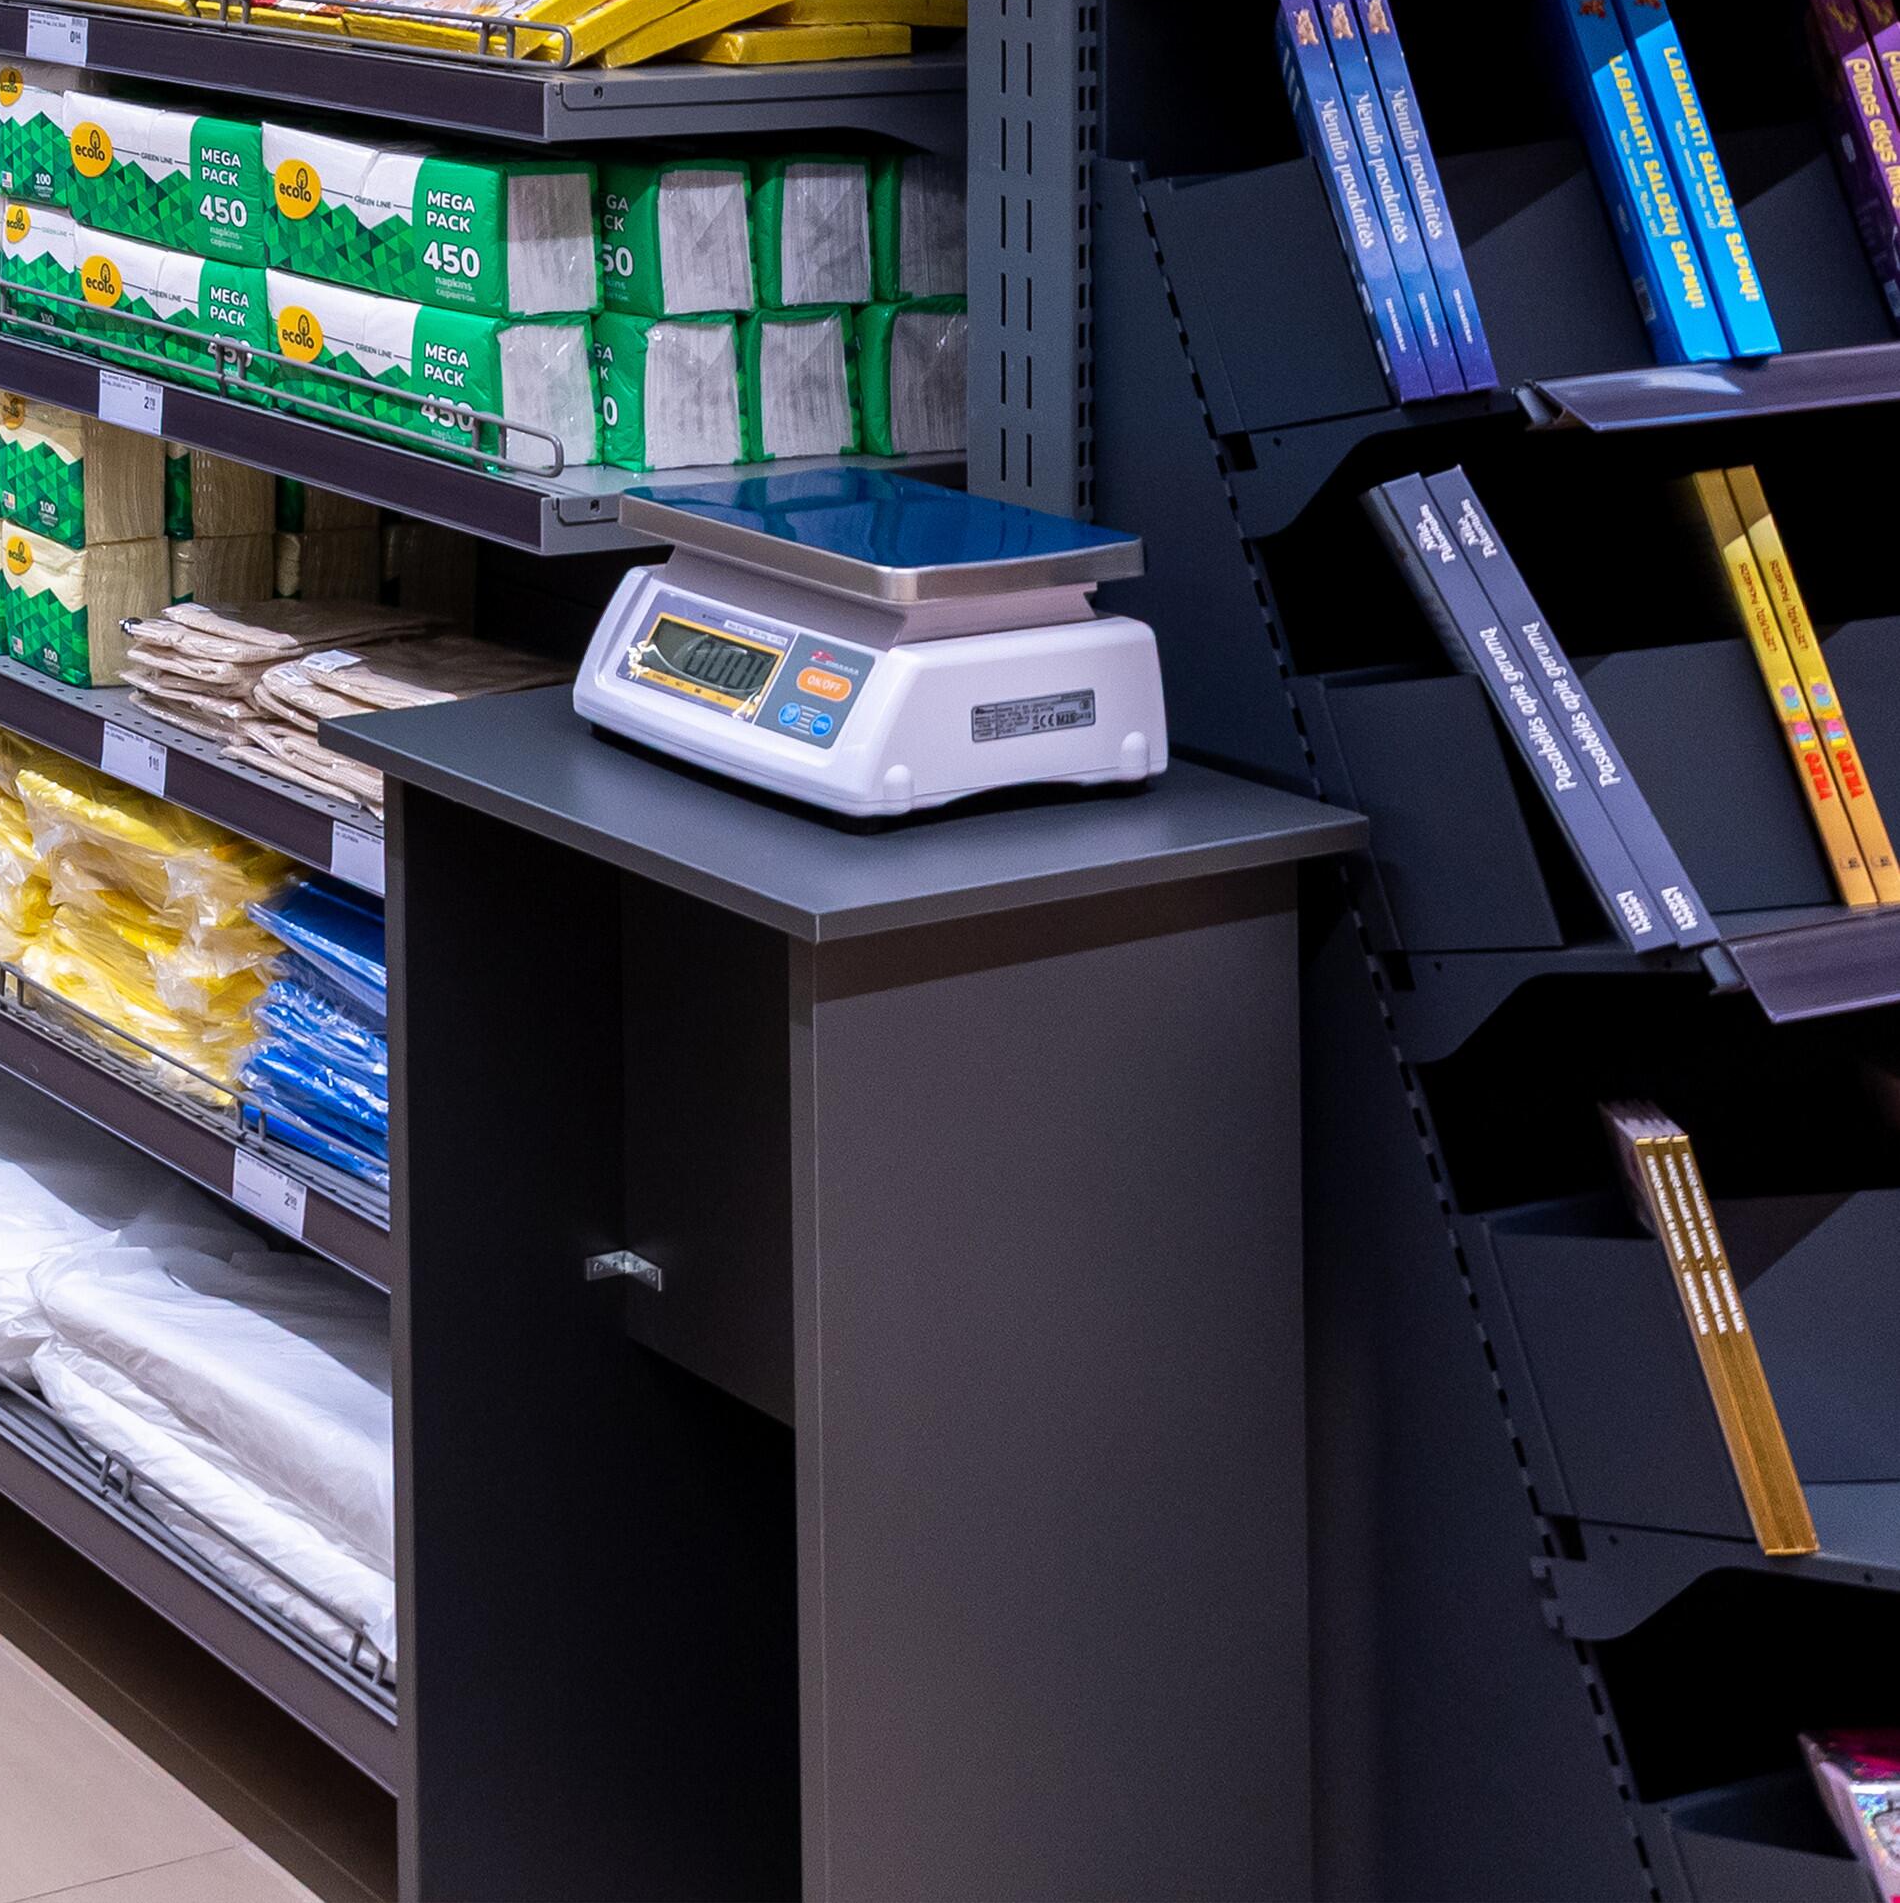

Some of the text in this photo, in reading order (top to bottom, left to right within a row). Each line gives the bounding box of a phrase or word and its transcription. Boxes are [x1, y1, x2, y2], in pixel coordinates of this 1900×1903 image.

[160, 156, 173, 164] LINE
[201, 147, 241, 168] MEGA
[1350, 89, 1409, 244] Mėnulio pasakaitės
[1385, 85, 1443, 241] Mėnulio pasakaitės
[35, 173, 51, 185] 100
[202, 166, 238, 187] PACK
[1316, 96, 1375, 249] Mėnulio pasakaitės
[1609, 55, 1706, 309] LABANAKT! SALDŽIŲ SAPNŲ!
[1663, 46, 1760, 302] LABANAKT! SALDŽIŲ SAPNŲ!
[200, 195, 247, 227] 450
[375, 198, 392, 209] LINE
[426, 189, 476, 213] MEGA
[606, 194, 629, 212] GA
[210, 226, 240, 240] napkins
[426, 211, 471, 233] PACK
[422, 241, 480, 278] 450
[435, 275, 472, 292] napkins
[168, 293, 181, 302] LINE
[210, 286, 249, 308] MEGA
[210, 306, 246, 327] PACK
[375, 347, 393, 359] LINE
[425, 342, 469, 368] MEGA
[424, 363, 465, 388] PACK
[39, 501, 55, 515] 100
[43, 648, 58, 661] 100
[1479, 626, 1578, 792] Pasakėlės apie gerumą
[1522, 621, 1621, 788] Pasakėlės apie gerumą
